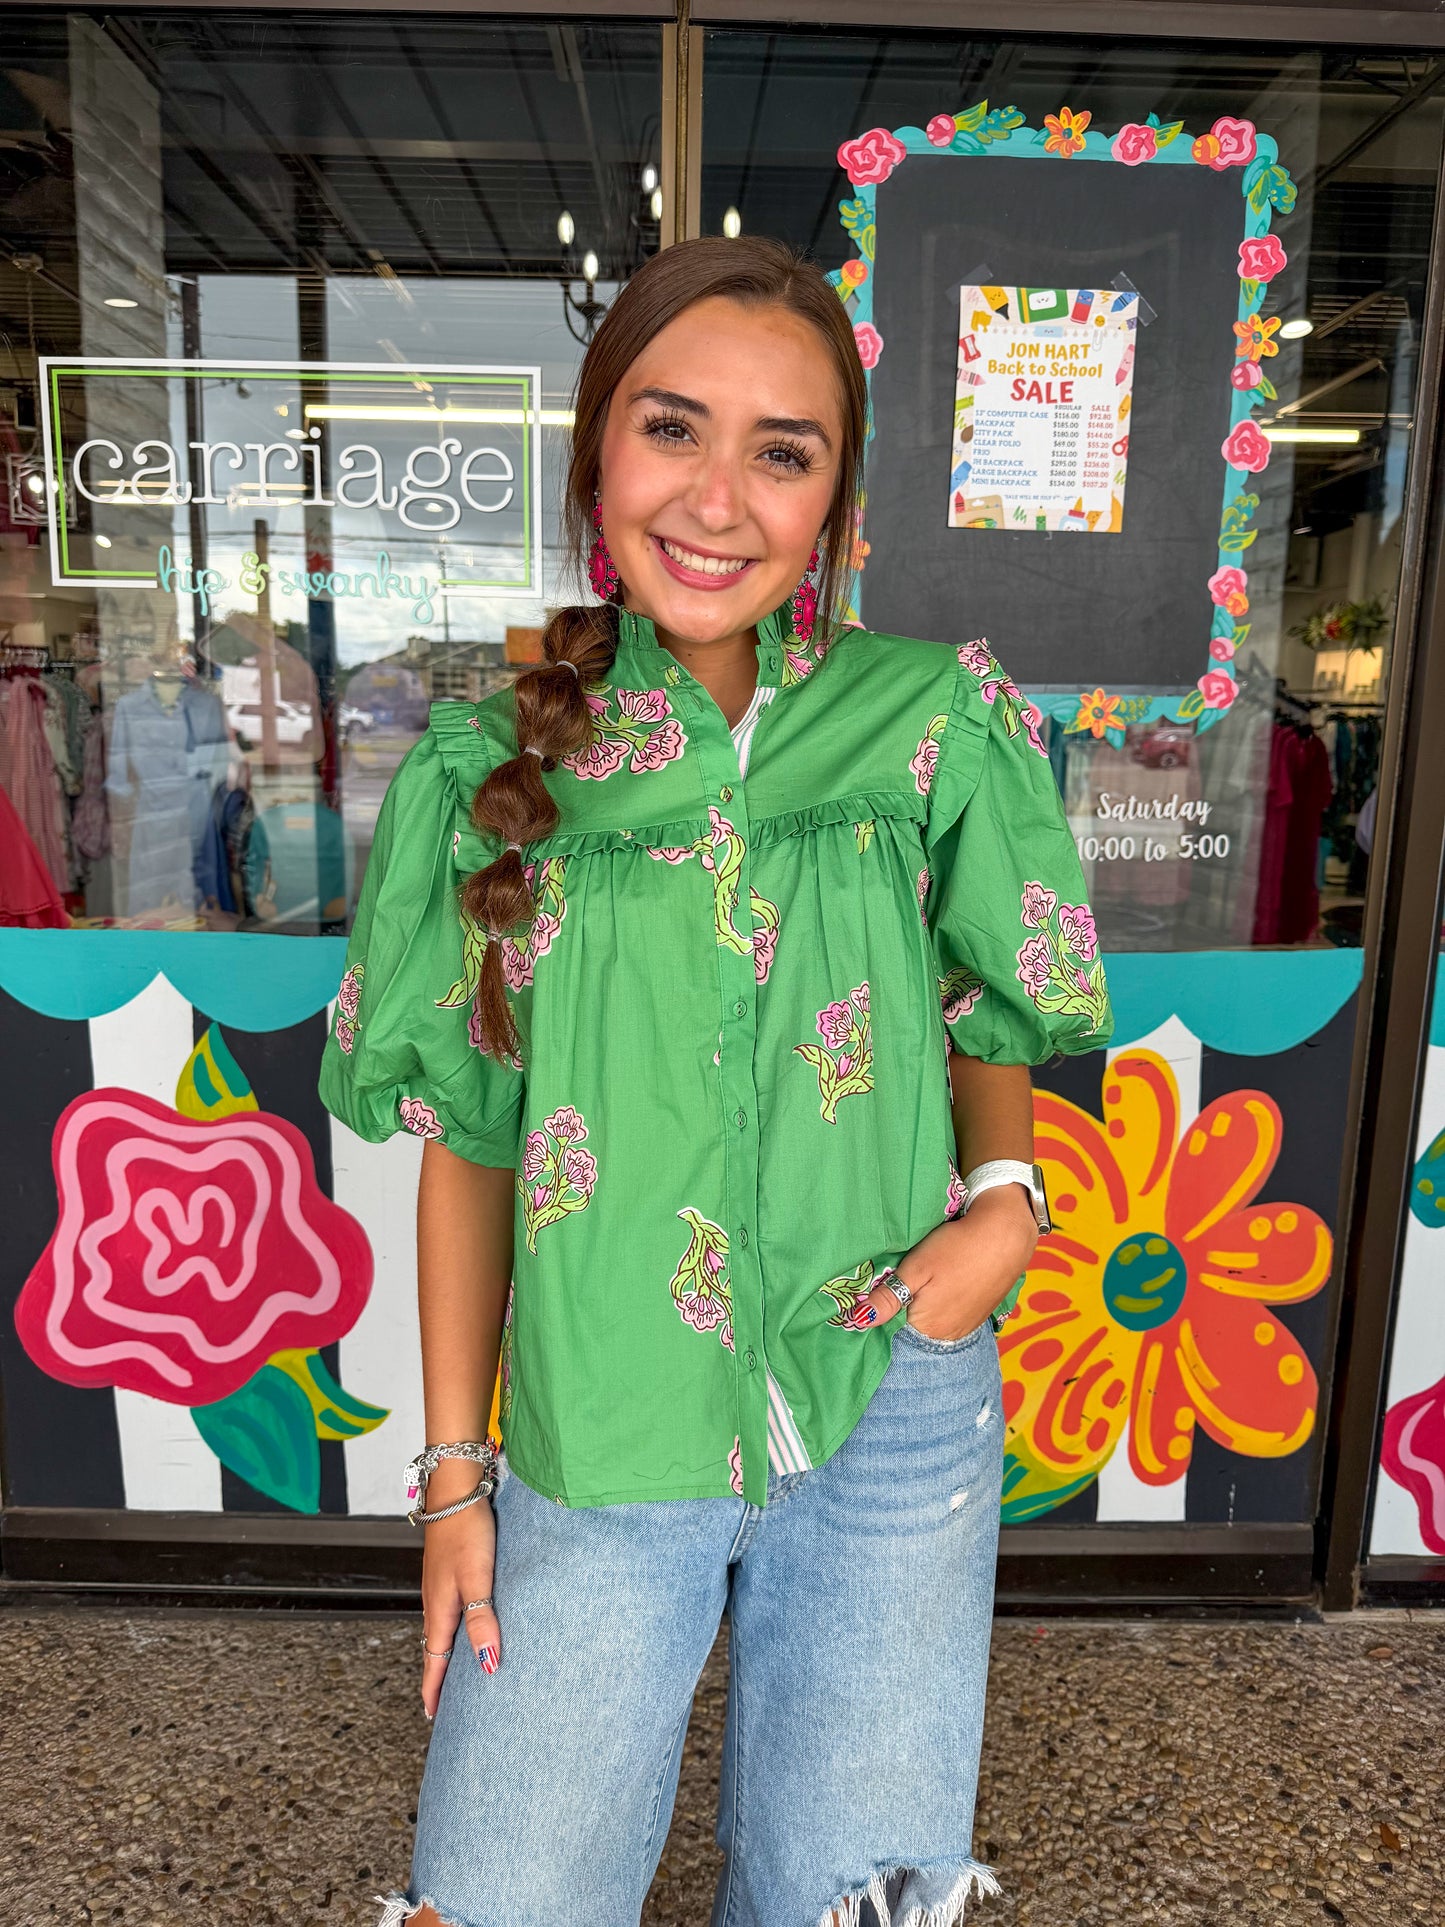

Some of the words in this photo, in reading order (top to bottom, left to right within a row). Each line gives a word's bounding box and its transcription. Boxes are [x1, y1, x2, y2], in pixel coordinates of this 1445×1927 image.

[1006, 342, 1040, 359] JON
[1045, 343, 1091, 361] HART
[988, 359, 1025, 376] Back
[1029, 362, 1046, 376] to
[1050, 361, 1103, 378] School
[1010, 378, 1074, 404] SALE
[975, 419, 1015, 427] BACKPACK
[1053, 421, 1079, 429] $185.00
[986, 410, 1028, 418] COMPUTER
[1029, 411, 1049, 419] CASE
[1051, 450, 1078, 458] $122.00
[73, 426, 515, 532] carriage
[972, 468, 995, 476] LARGE
[996, 469, 1038, 477] BACKPACK
[156, 544, 232, 616] hip
[239, 551, 271, 595] &
[278, 550, 442, 625] swanky
[1096, 792, 1213, 826] Saturday
[1075, 836, 1135, 862] 10:00
[1144, 837, 1168, 862] to
[1178, 834, 1230, 860] 5:00
